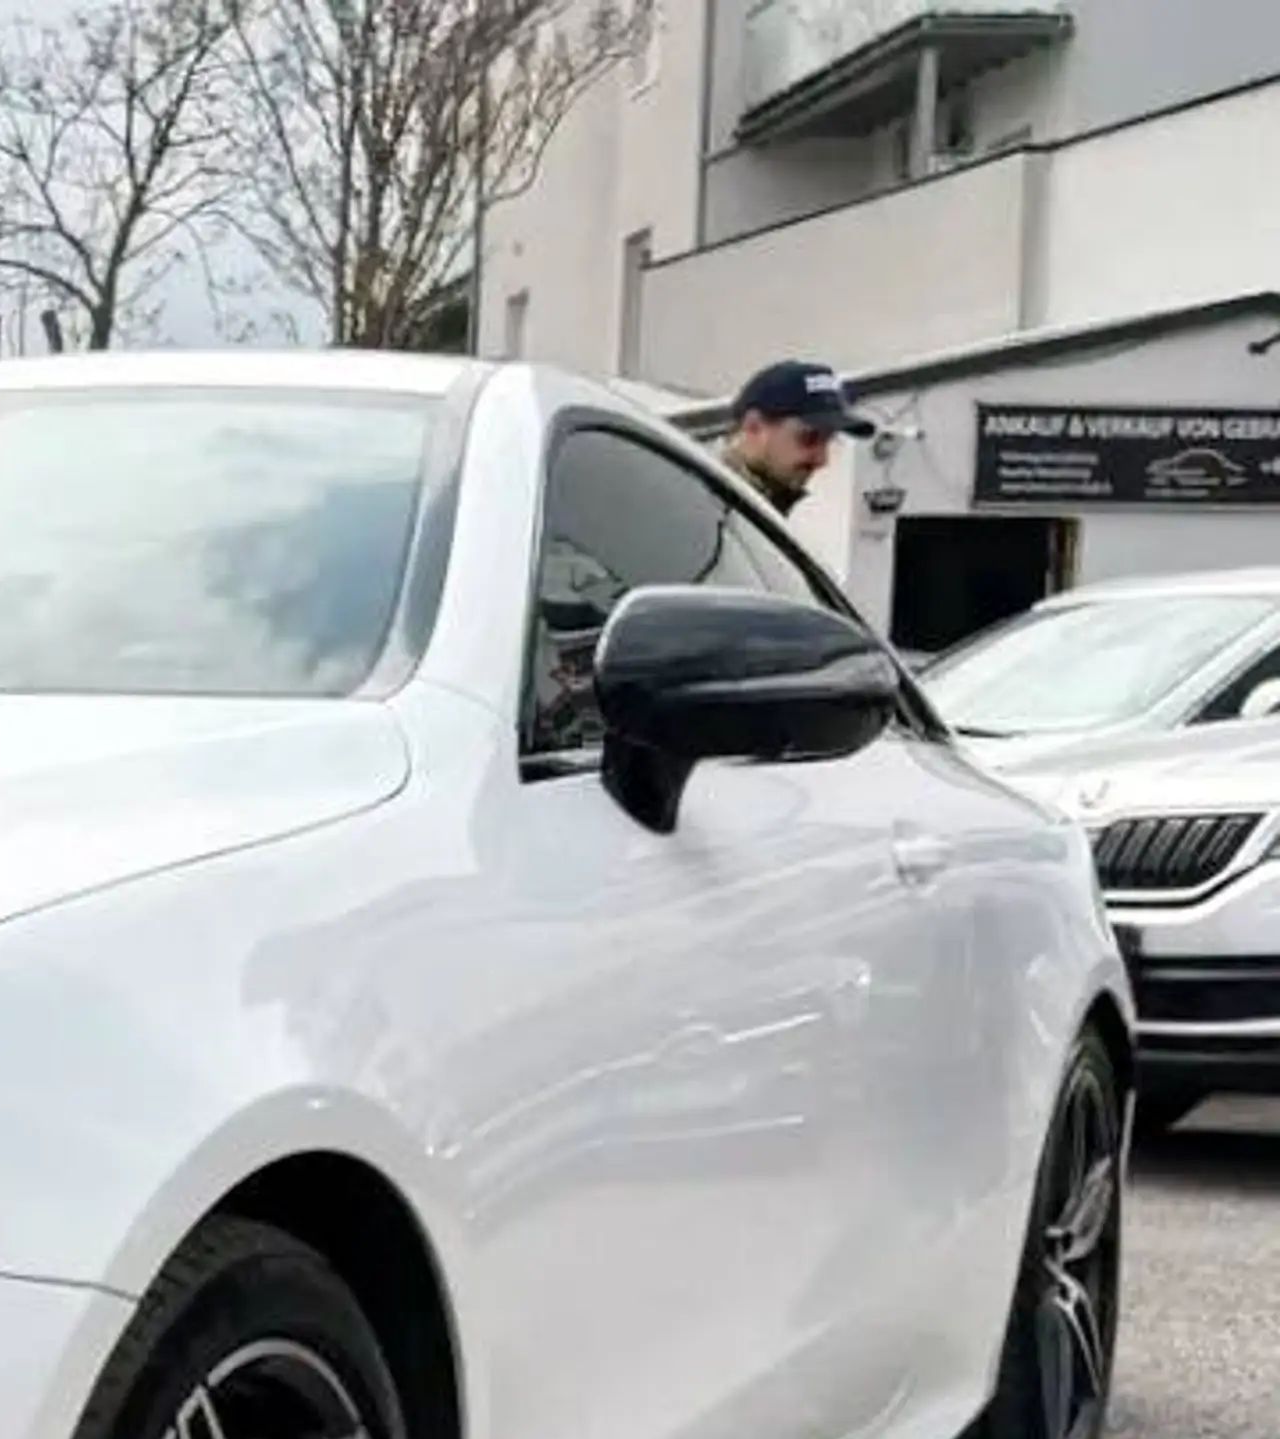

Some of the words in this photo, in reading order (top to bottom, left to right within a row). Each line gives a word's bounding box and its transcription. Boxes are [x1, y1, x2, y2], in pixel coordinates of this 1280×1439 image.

[985, 415, 1067, 437] ANKAUF
[1085, 415, 1175, 439] VERKAUF
[1177, 416, 1222, 440] VON
